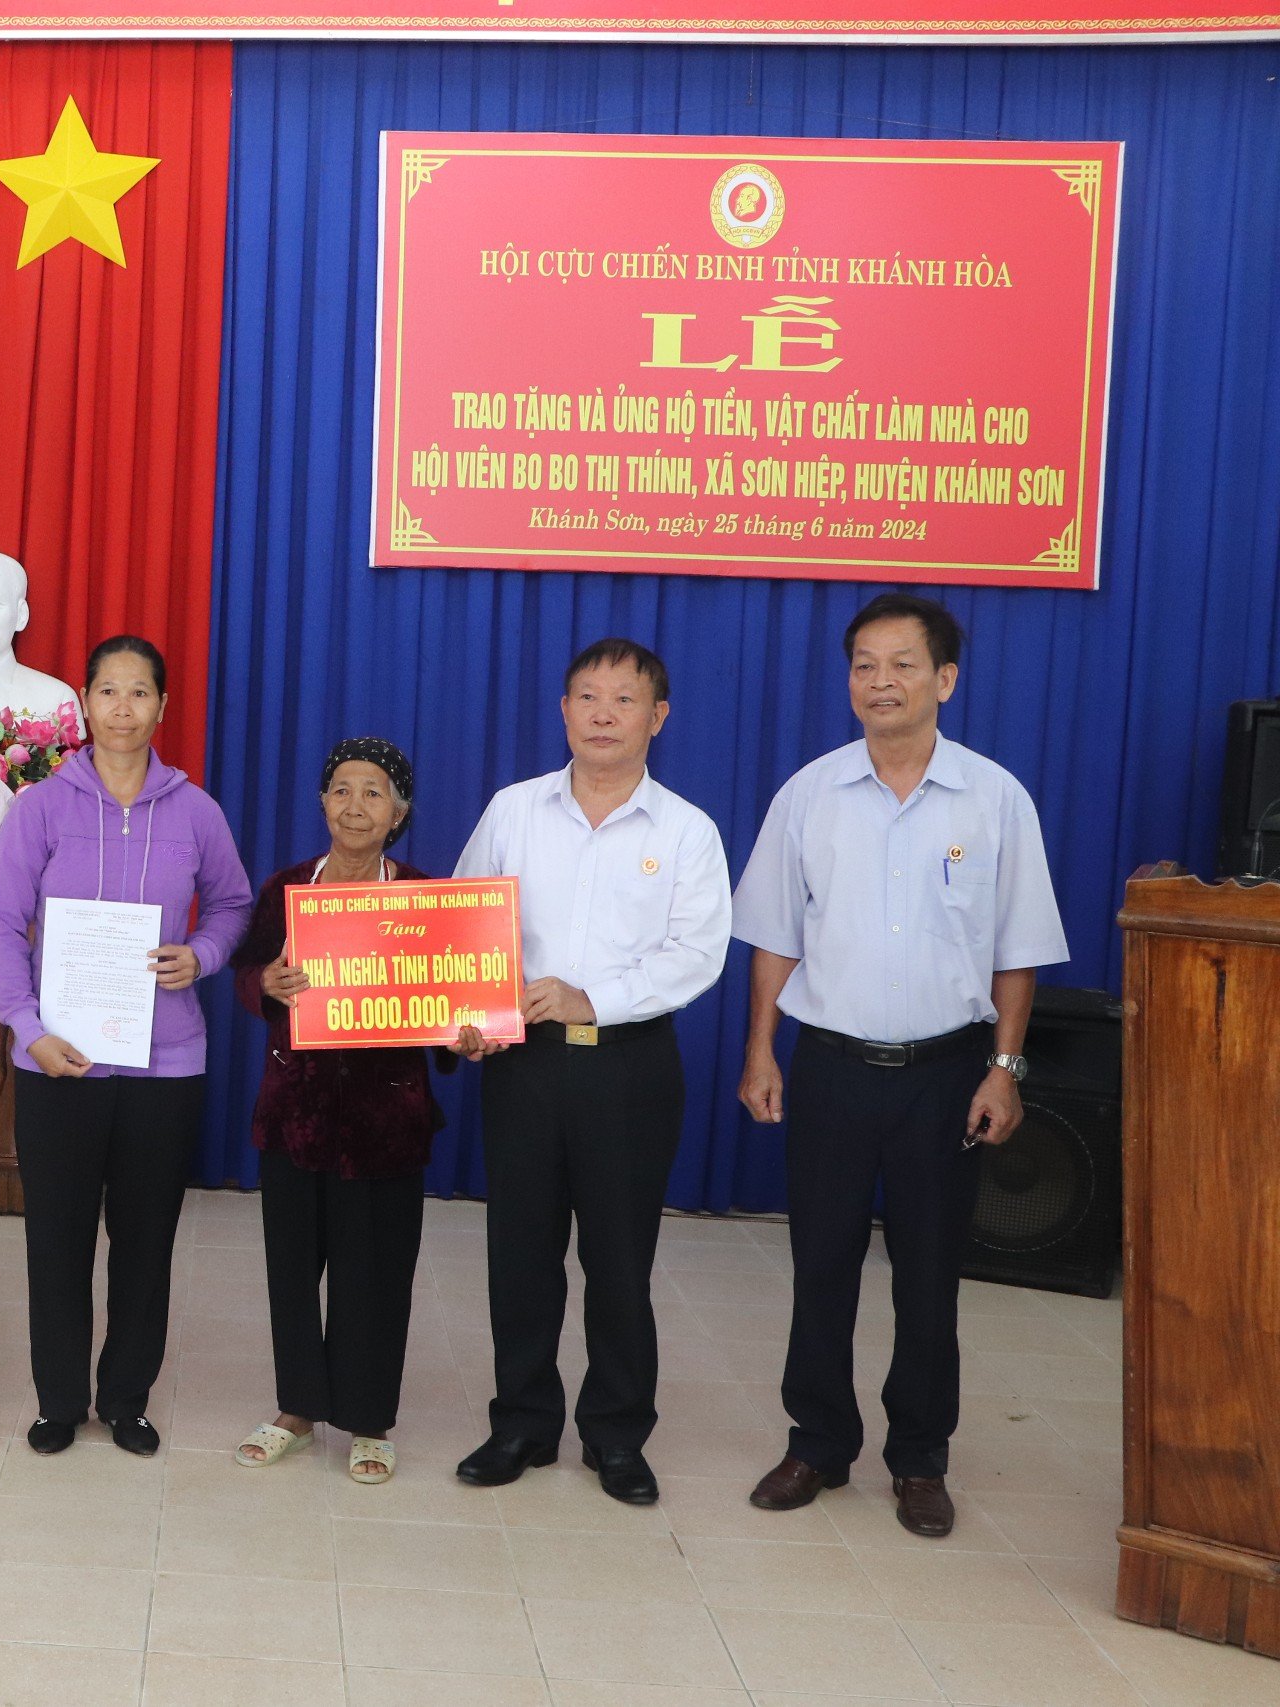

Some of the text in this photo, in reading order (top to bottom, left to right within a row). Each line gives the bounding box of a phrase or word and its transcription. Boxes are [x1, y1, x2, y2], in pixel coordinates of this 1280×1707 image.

[479, 241, 1013, 288] HỘI CỰU CHIẾN BINH TỈNH KHÁNH HÒA
[639, 294, 844, 373] LỄ
[451, 383, 1029, 446] TRAO TẶNG VÀ ỦNG HỘ TIỀN, VẬT CHẤT LÀM NHÀ CHO
[411, 442, 1065, 510] HỘI VIÊN BO BO THỊ THÍNH, XÃ SƠN HIỆP, HUYỆN KHÁNH SƠN
[527, 507, 927, 541] Khánh Sơn, ngày 25 tháng 6 năm 2024
[299, 889, 505, 917] HỘI CỰU CHIẾN BINH TỈNH KHÁNH HÒA
[377, 920, 426, 938] Tặng
[301, 943, 509, 989] NHÀ NGHĨA TÌNH ĐỒNG ĐỘI
[326, 994, 488, 1031] 60.000.000 đồng
